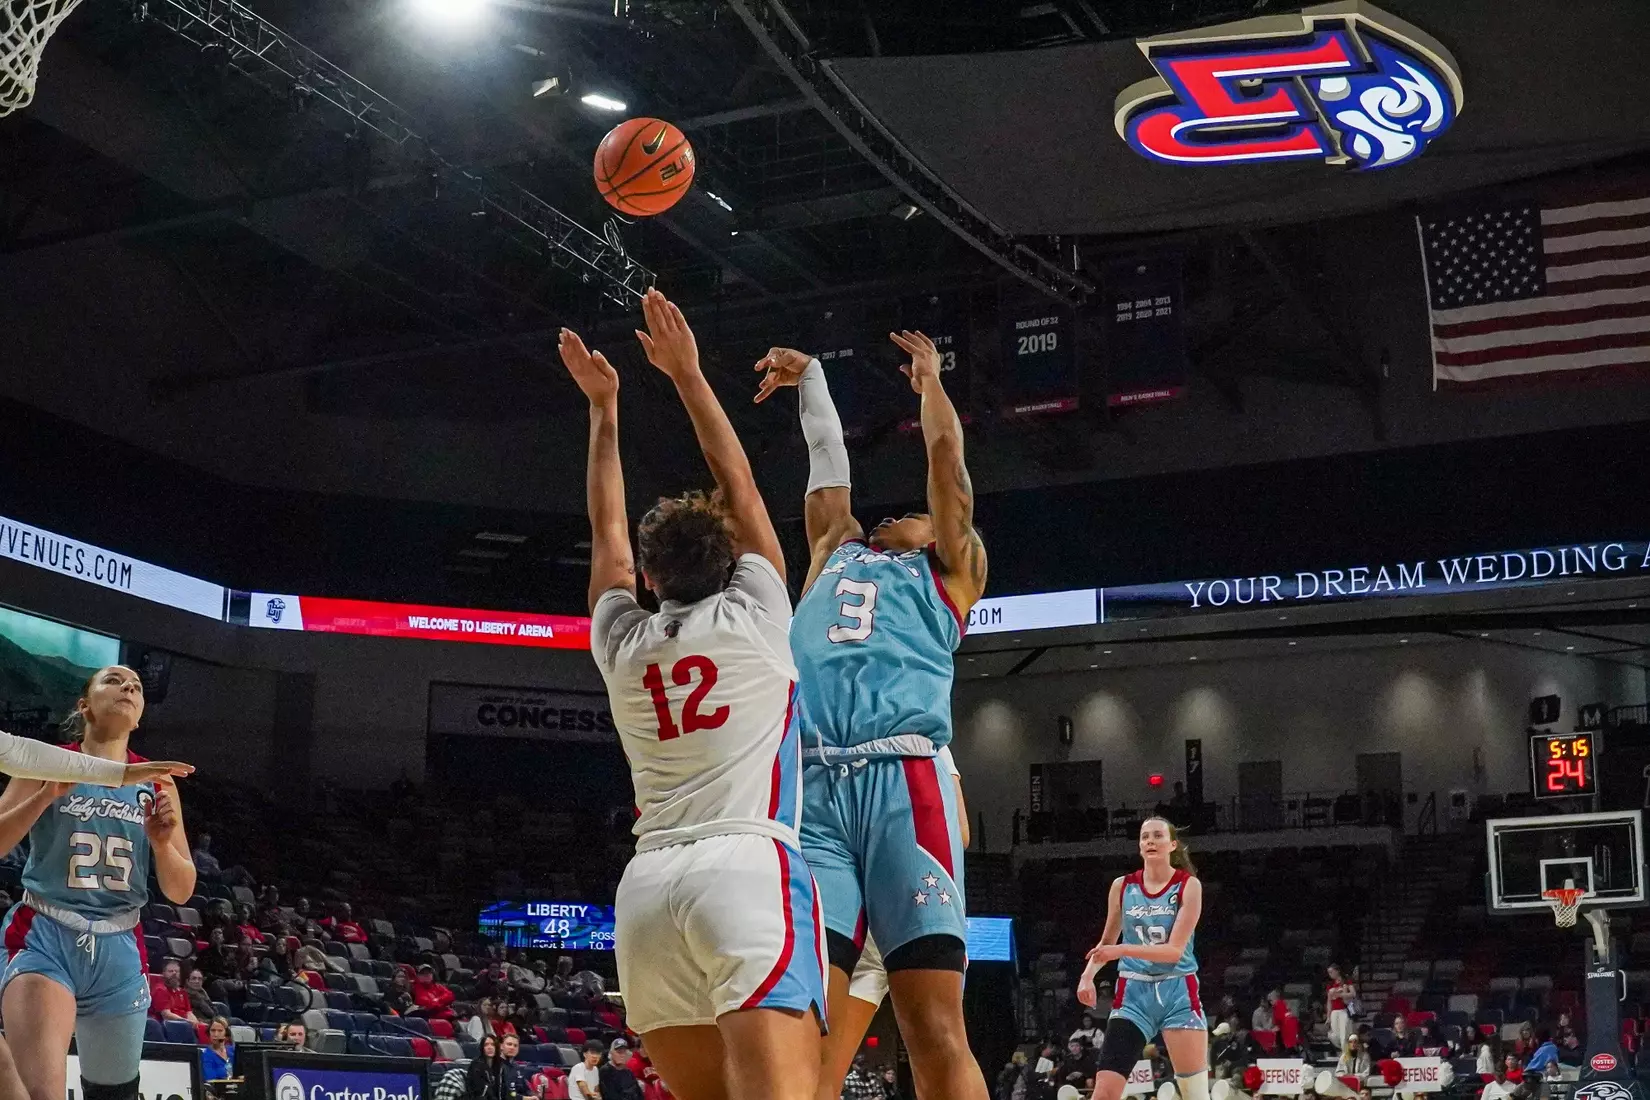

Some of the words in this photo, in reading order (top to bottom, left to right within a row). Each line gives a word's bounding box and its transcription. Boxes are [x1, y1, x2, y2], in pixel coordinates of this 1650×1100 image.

[1015, 318, 1040, 330] ROUND
[1017, 332, 1058, 355] 2019
[1184, 575, 1285, 608] YOUR
[1295, 561, 1426, 599] DREAM
[1437, 543, 1629, 585] WEDDING
[827, 577, 878, 643] 3
[408, 615, 459, 631] WELCOME
[460, 619, 475, 631] TO
[475, 620, 516, 636] LIBERTY
[518, 626, 554, 638] ARENA
[642, 654, 730, 741] 12
[1549, 738, 1589, 759] 5:15
[1547, 759, 1585, 791] 24
[1031, 775, 1041, 812] OMEN
[59, 794, 96, 822] Lady
[67, 831, 134, 892] 25
[527, 903, 588, 917] LIBERTY
[543, 918, 570, 939] 48
[1587, 970, 1616, 979] SPALDING
[1402, 1067, 1438, 1082] EFENSE
